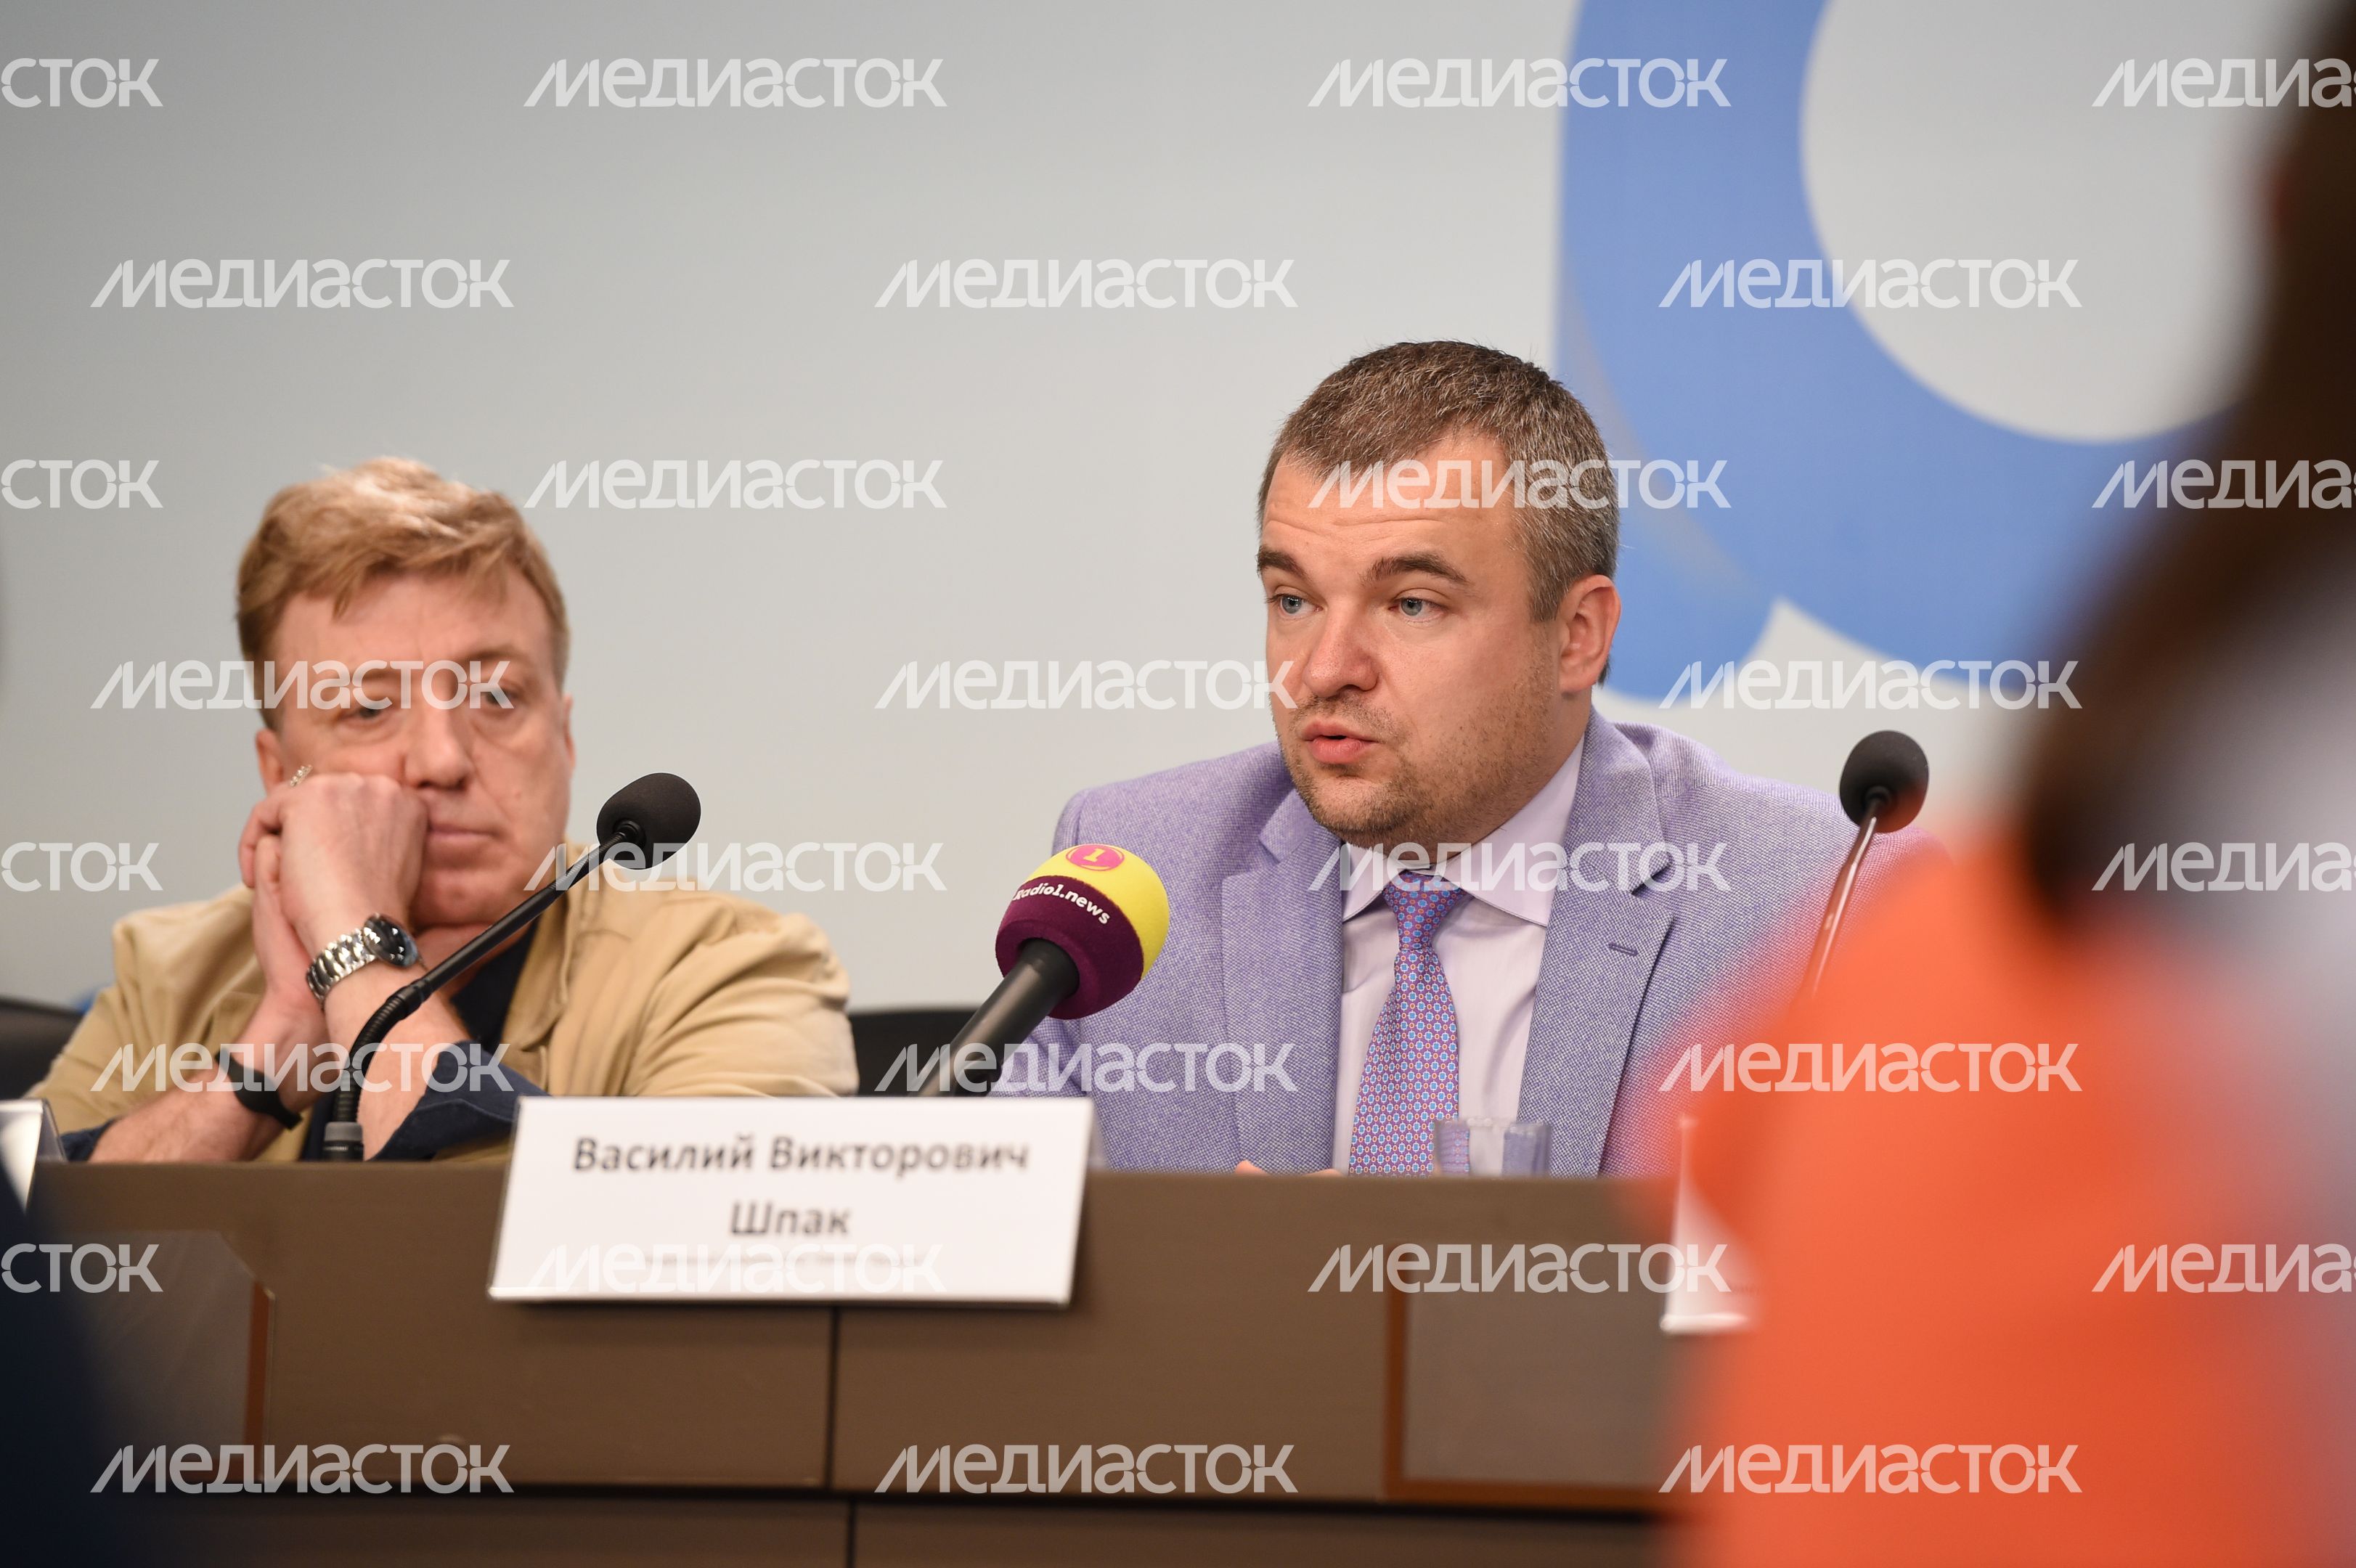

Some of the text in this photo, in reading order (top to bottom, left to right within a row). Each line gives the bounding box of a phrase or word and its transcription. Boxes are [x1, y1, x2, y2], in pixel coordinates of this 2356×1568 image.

[1083, 848, 1105, 862] 1
[573, 1133, 1030, 1178] Василий Викторович
[730, 1201, 852, 1237] Шпак
